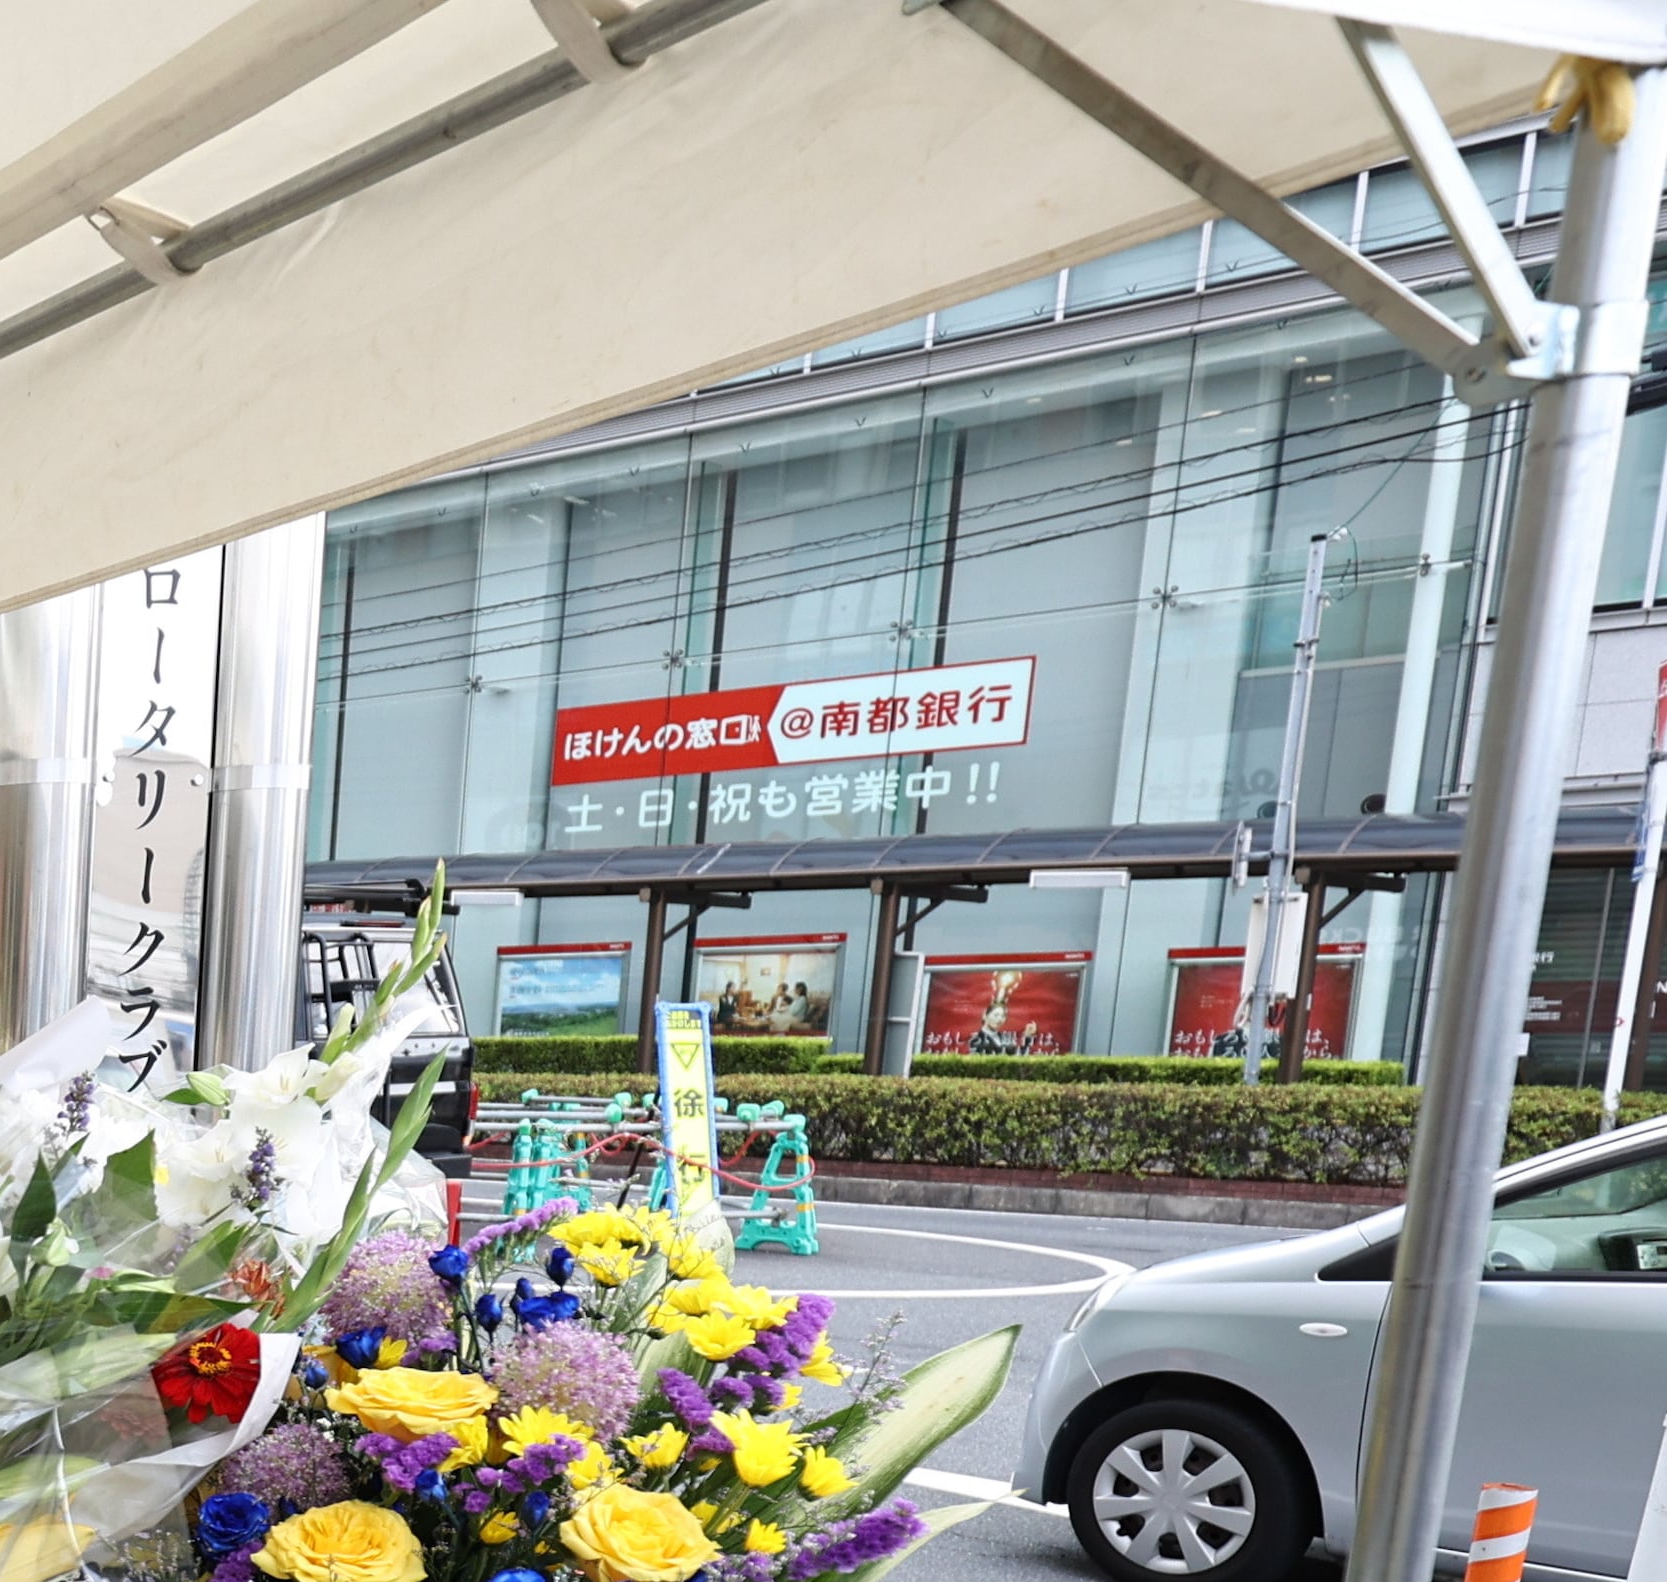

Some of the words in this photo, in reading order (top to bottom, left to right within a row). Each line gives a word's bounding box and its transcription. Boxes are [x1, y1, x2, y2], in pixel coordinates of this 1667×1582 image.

[563, 715, 750, 761] ほけんの窓口
[779, 684, 1013, 740] @南都銀行
[119, 567, 181, 1093] ロータリークラブ
[673, 1088, 706, 1184] 徐行
